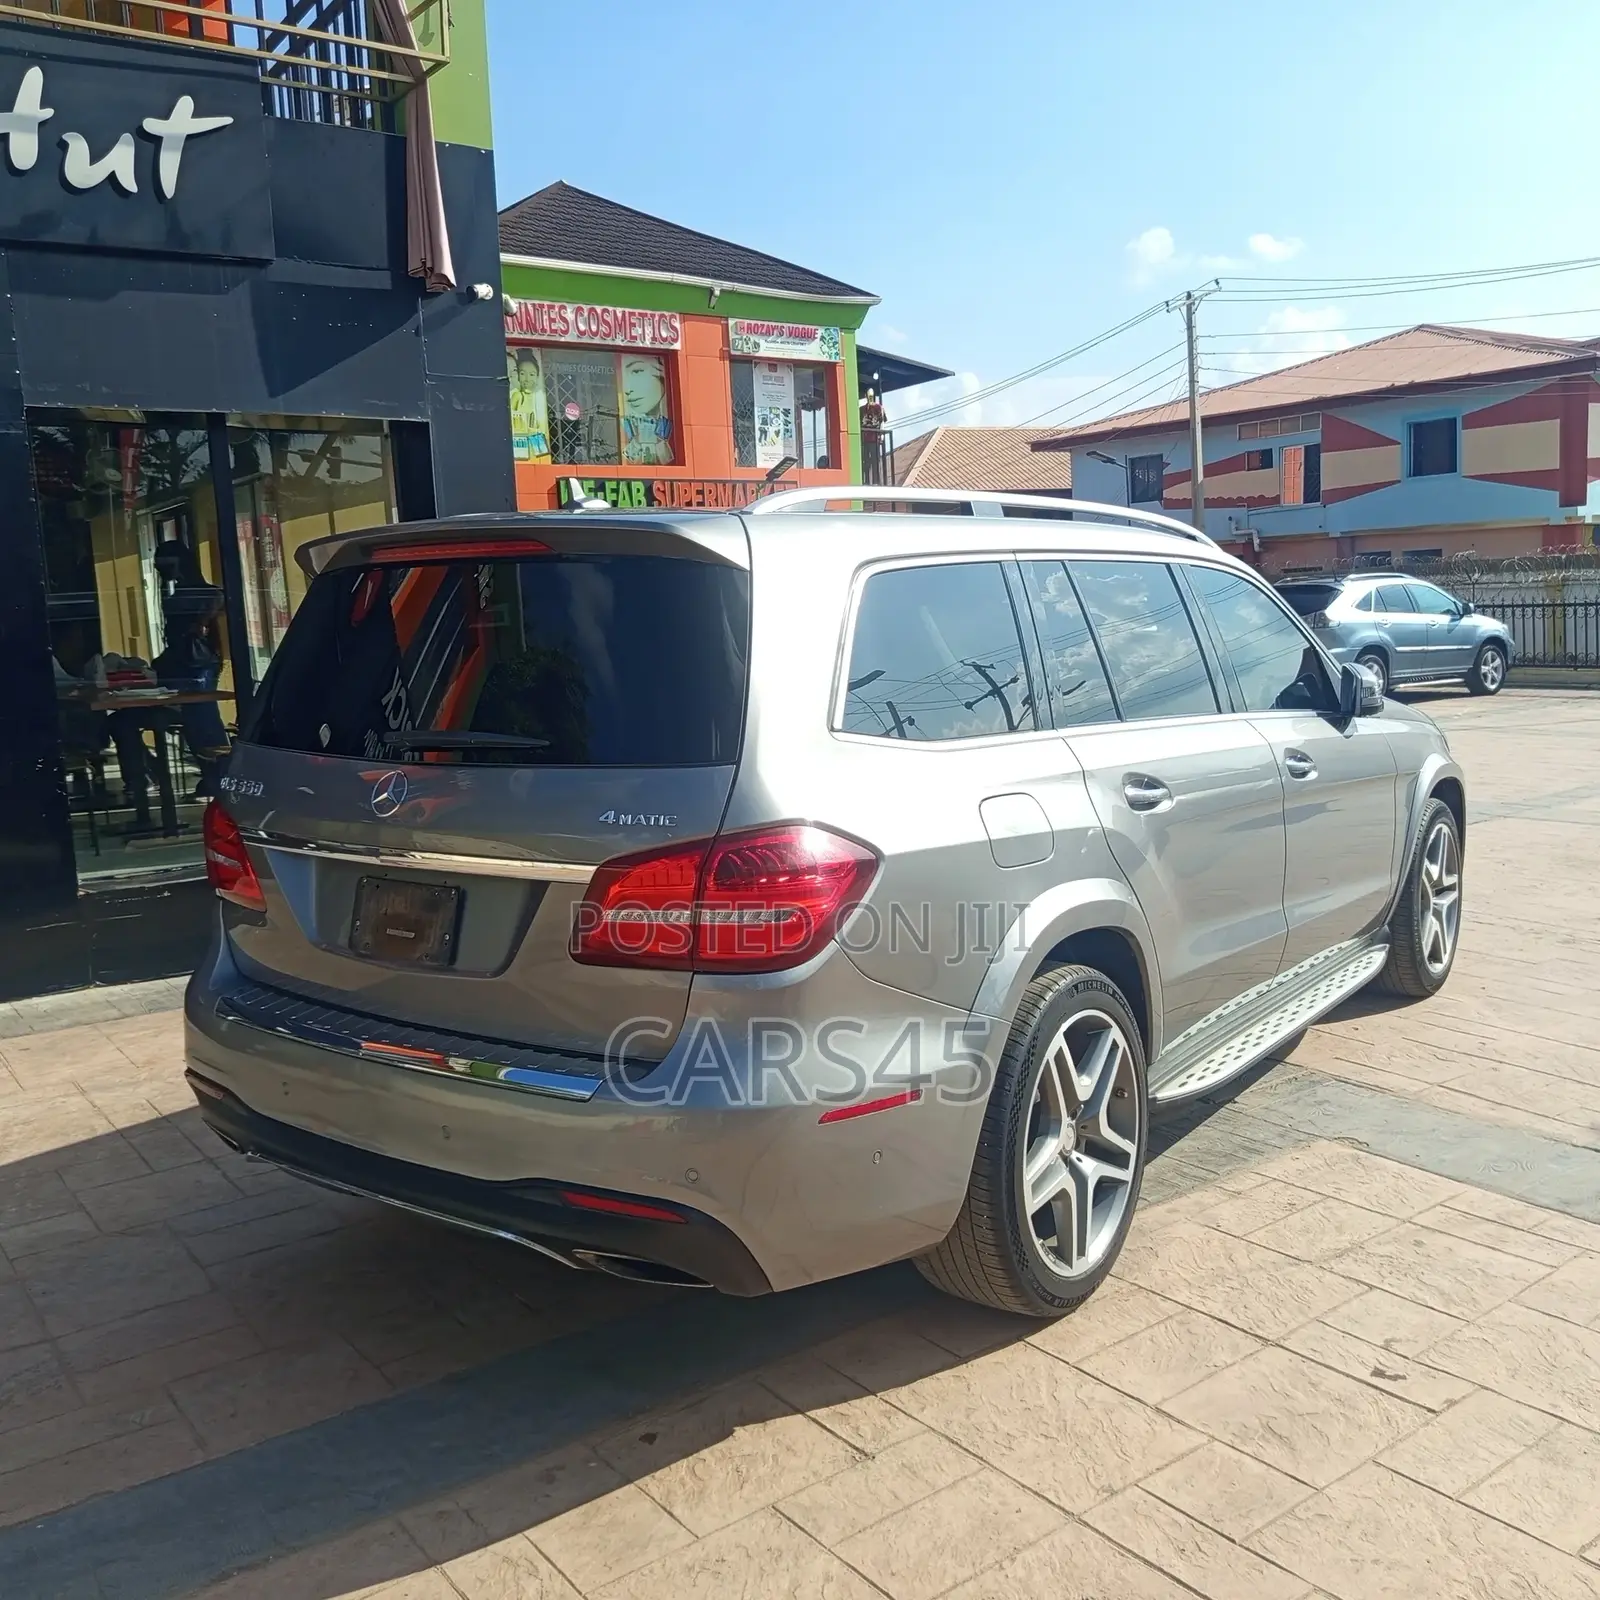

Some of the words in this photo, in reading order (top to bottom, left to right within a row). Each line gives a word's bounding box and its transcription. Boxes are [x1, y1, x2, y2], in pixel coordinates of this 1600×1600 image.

[574, 305, 680, 344] COSMETICS
[746, 322, 785, 338] ROZAY'S
[787, 327, 819, 340] VOGUE
[652, 480, 798, 508] SUPERMAR
[1077, 980, 1114, 995] MICHELIN
